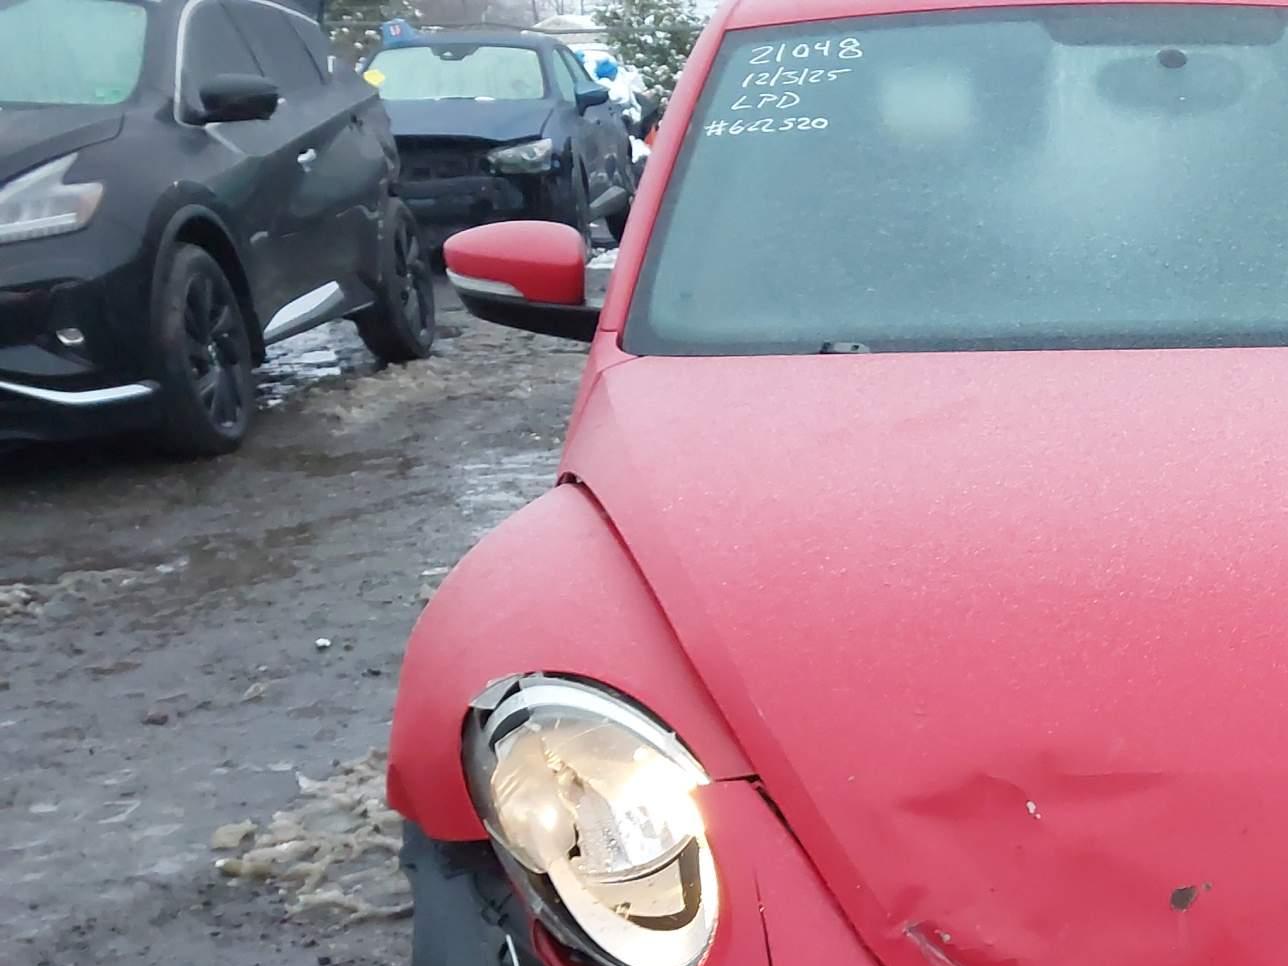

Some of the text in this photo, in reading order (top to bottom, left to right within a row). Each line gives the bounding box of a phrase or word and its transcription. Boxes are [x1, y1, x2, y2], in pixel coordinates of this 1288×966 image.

[749, 37, 864, 65] 21048
[741, 66, 852, 88] 12/3/25
[730, 91, 800, 110] LPD
